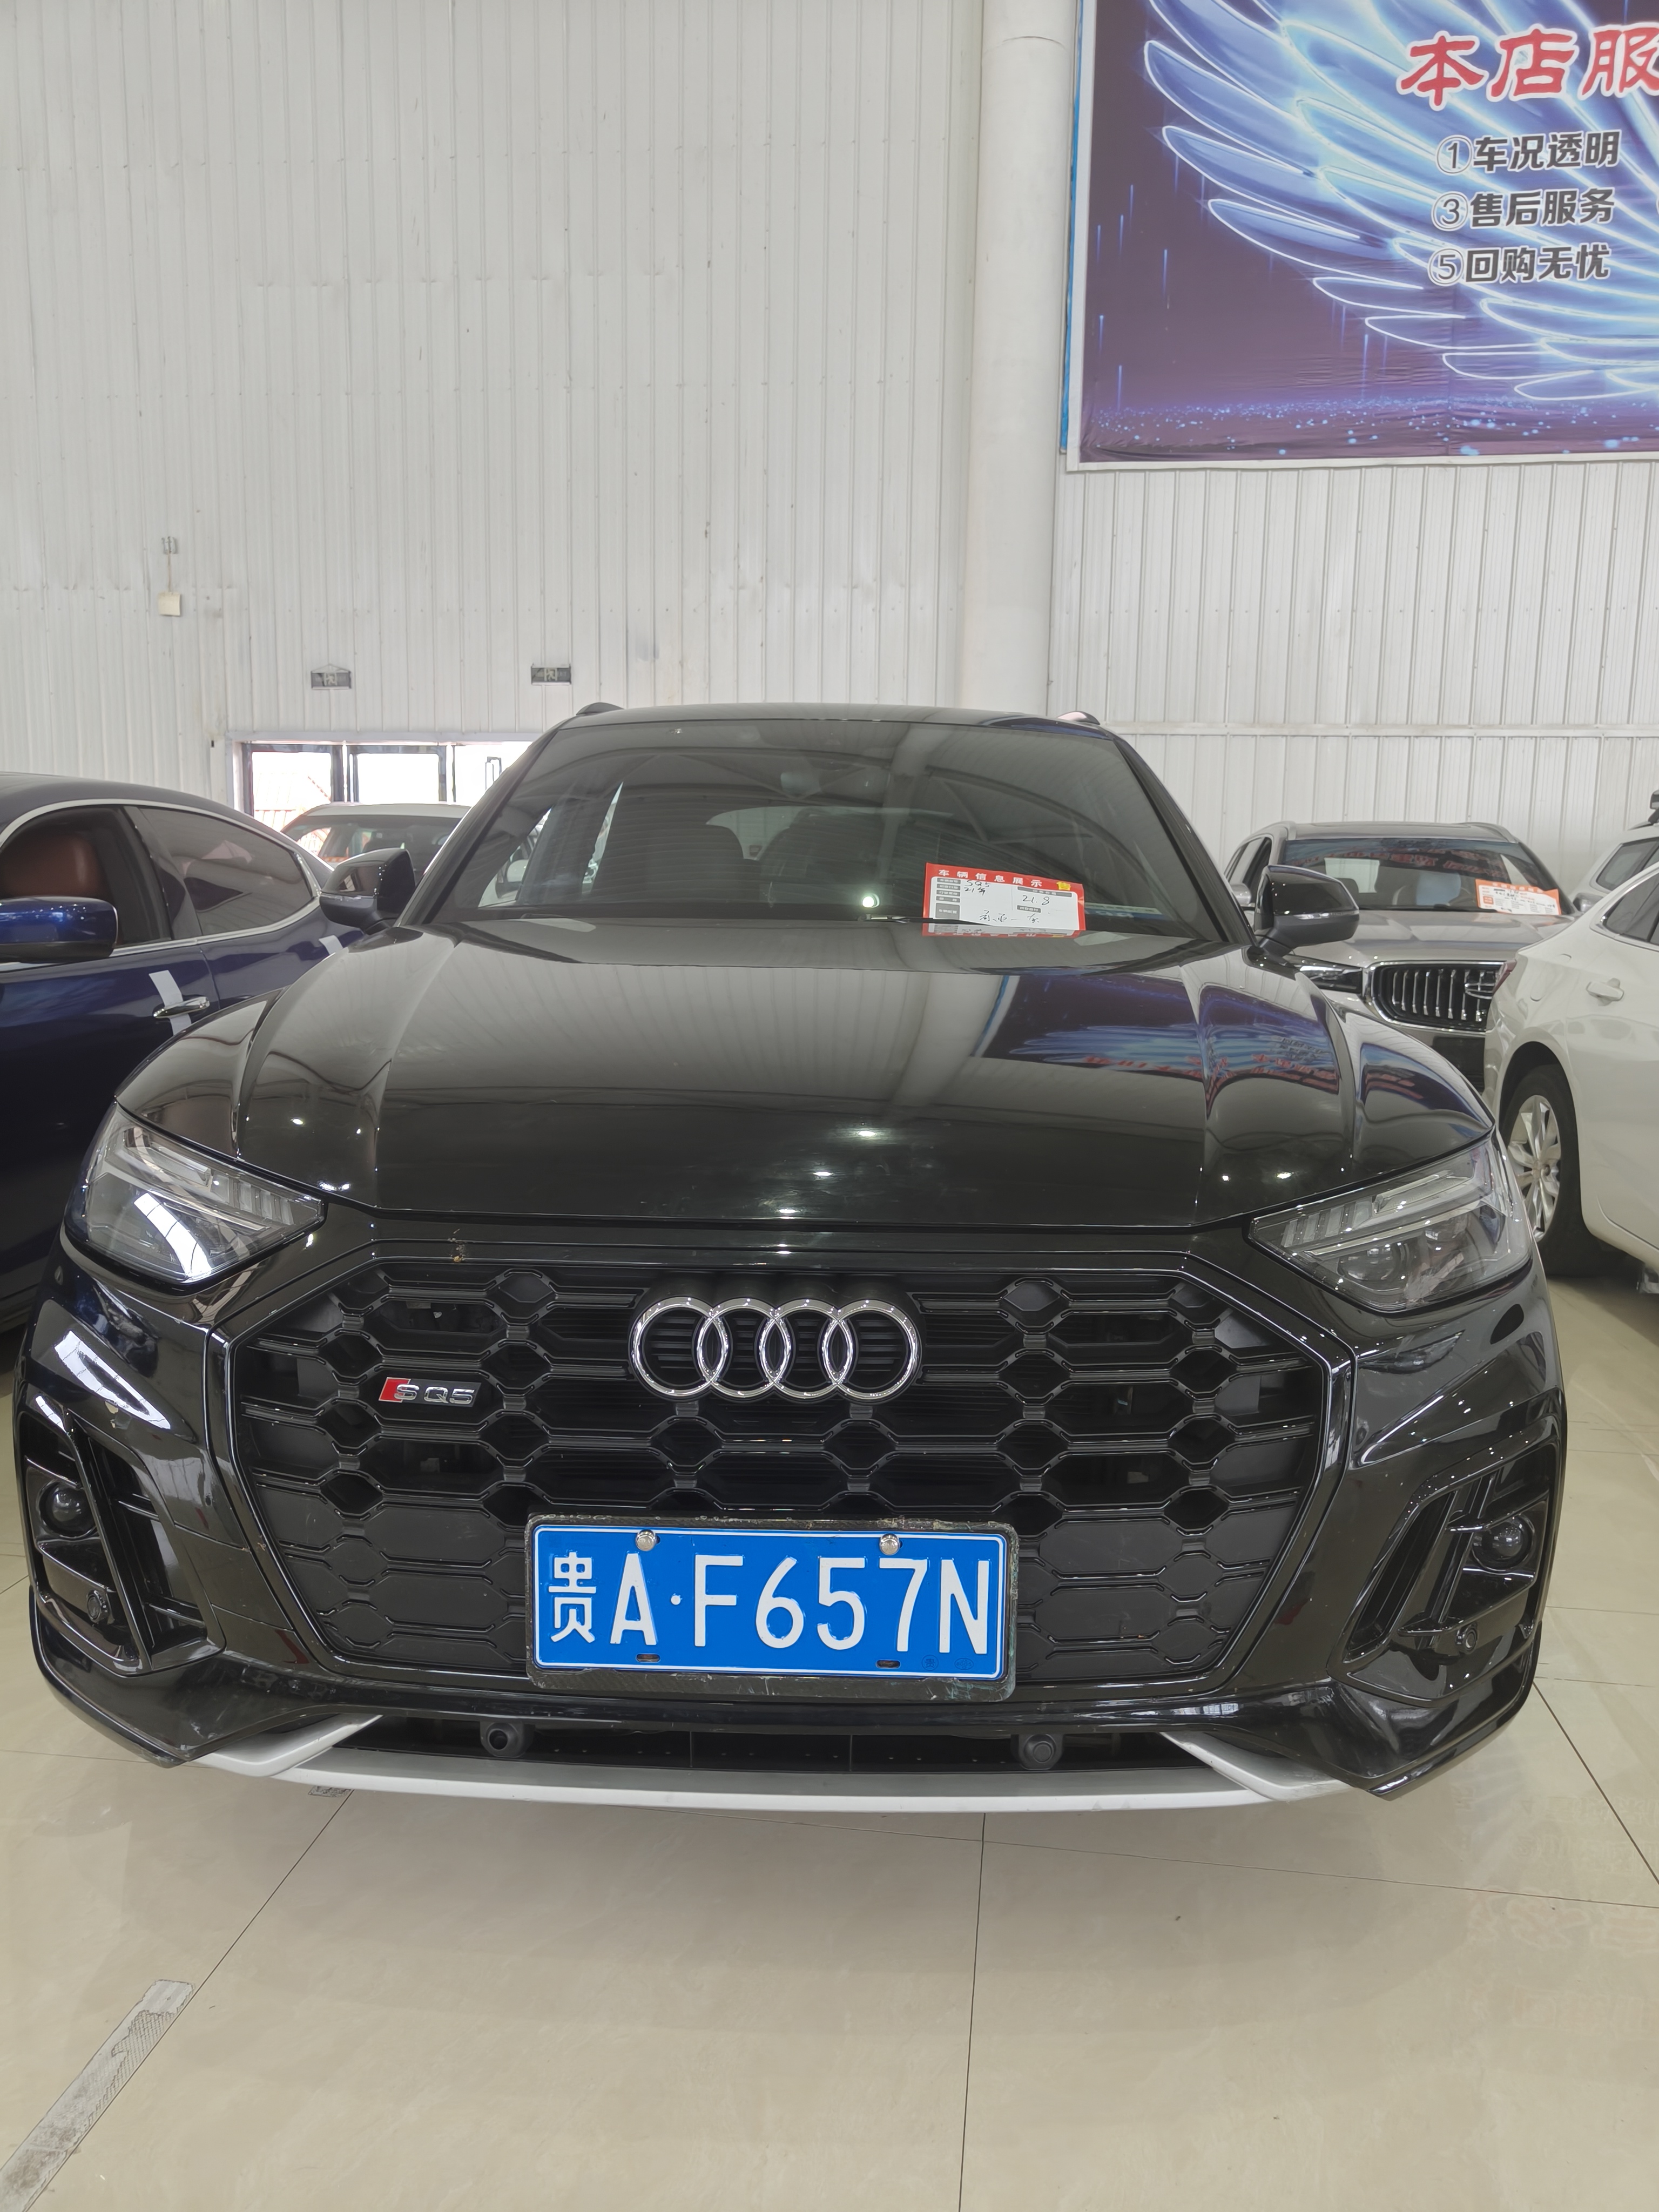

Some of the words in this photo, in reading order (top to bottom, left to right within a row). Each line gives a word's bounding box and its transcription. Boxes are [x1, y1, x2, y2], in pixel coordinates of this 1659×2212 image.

[1399, 24, 1659, 108] 本店服
[548, 1551, 990, 1655] 贵A·F657N
